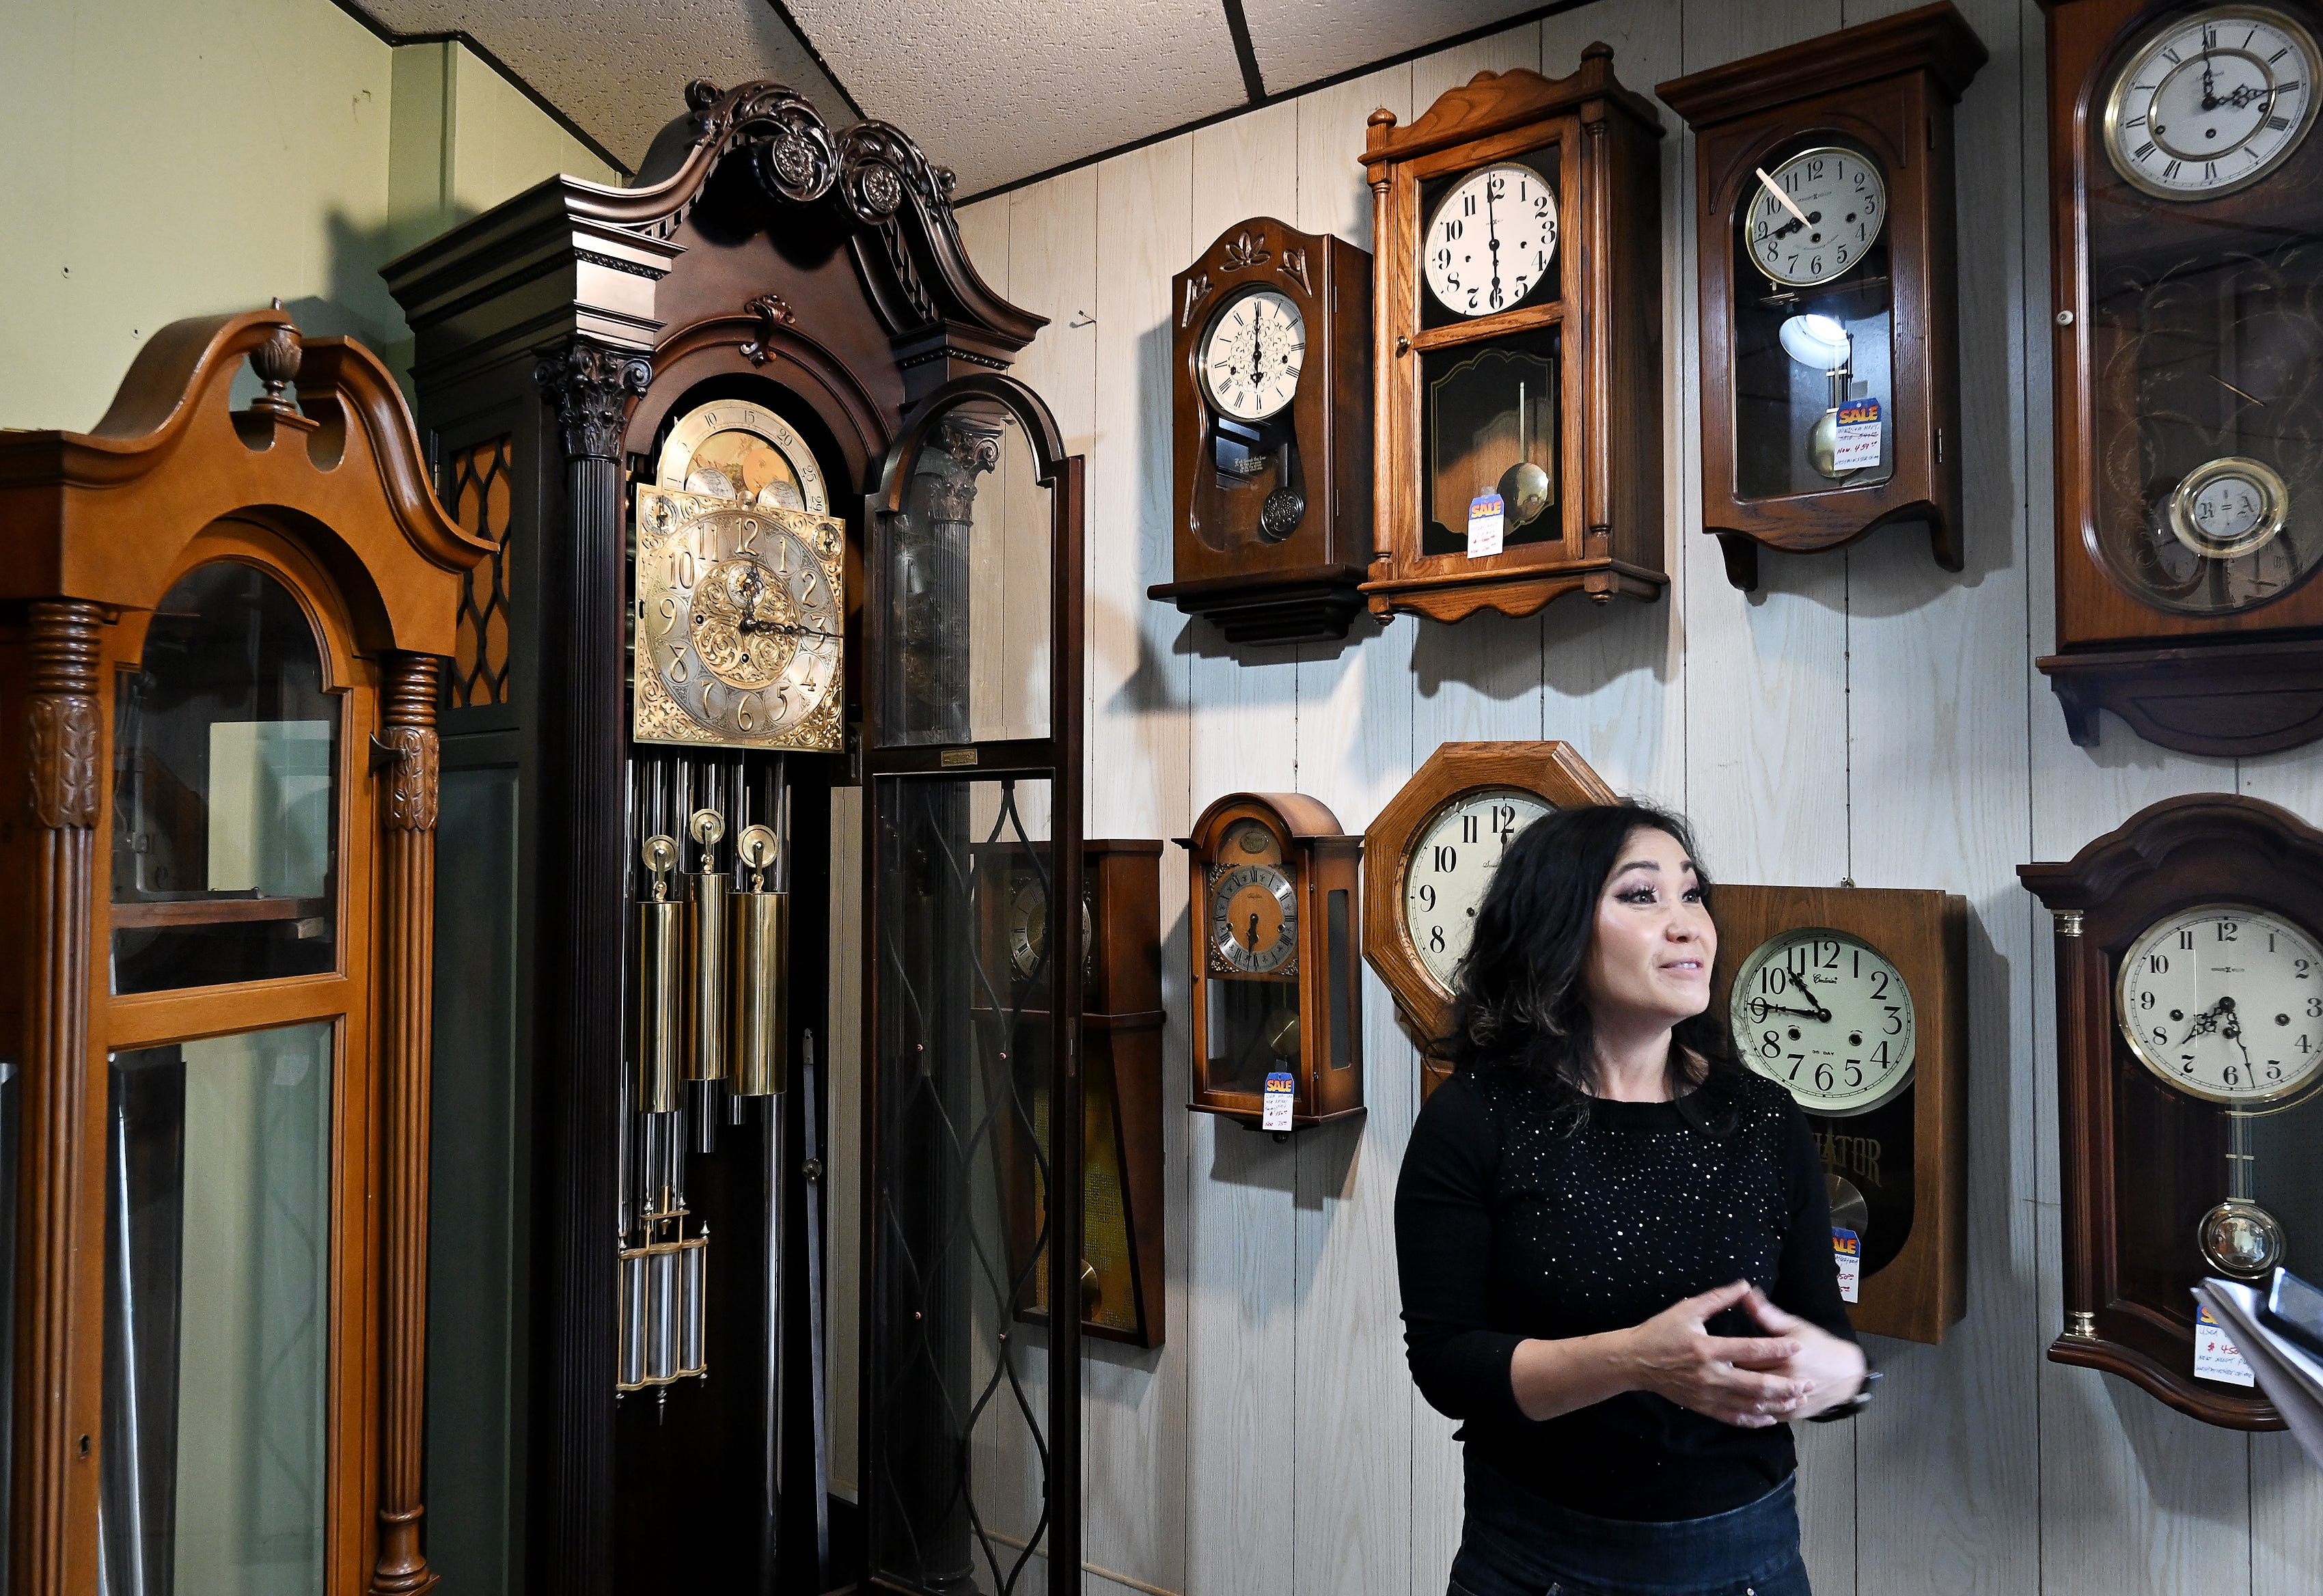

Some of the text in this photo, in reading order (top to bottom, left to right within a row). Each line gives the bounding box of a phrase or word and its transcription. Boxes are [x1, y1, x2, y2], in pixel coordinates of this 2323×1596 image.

[1807, 160, 1824, 182] 12
[1837, 161, 1843, 180] 1
[1487, 178, 1505, 203] 12
[1520, 181, 1526, 202] 1
[1785, 173, 1798, 193] 11
[1854, 172, 1865, 193] 2
[1465, 195, 1476, 217] 11
[1534, 197, 1548, 219] 2
[1766, 195, 1782, 215] 10
[1865, 194, 1875, 215] 3
[1446, 219, 1463, 242] 10
[1541, 221, 1556, 244] 3
[1758, 221, 1768, 238] 9
[1855, 223, 1866, 240] 4
[1438, 248, 1451, 270] 9
[1531, 251, 1547, 271] 4
[1767, 241, 1778, 262] 8
[1837, 244, 1847, 264] 5
[1788, 254, 1799, 274] 7
[1811, 255, 1822, 275] 6
[1447, 272, 1460, 293] 8
[1515, 275, 1528, 297] 5
[1468, 287, 1479, 308] 7
[1489, 288, 1503, 309] 6
[704, 412, 717, 427] 10
[745, 410, 755, 424] 15
[1839, 405, 1878, 424] SALE
[778, 428, 793, 446] 20
[803, 465, 816, 482] 25
[812, 497, 823, 512] 29
[1470, 499, 1502, 519] SALE
[698, 523, 719, 562] 11
[736, 517, 760, 556] 12
[780, 536, 788, 573] 1
[670, 551, 696, 590] 10
[803, 573, 819, 607] 2
[659, 598, 676, 635] 9
[811, 615, 827, 651] 3
[670, 645, 688, 683] 8
[800, 657, 816, 692] 4
[701, 681, 713, 719] 7
[773, 685, 789, 721] 5
[738, 695, 754, 732] 6
[1462, 815, 1477, 843] 11
[1492, 805, 1515, 834] 12
[1433, 845, 1457, 872] 10
[1419, 884, 1435, 912] 9
[1429, 925, 1445, 953] 8
[2180, 931, 2193, 950] 11
[2217, 922, 2238, 941] 12
[2268, 933, 2275, 952] 1
[1788, 947, 1805, 976] 11
[1813, 940, 1841, 968] 12
[1854, 950, 1858, 978] 1
[2150, 954, 2169, 974] 10
[2295, 959, 2309, 978] 2
[1761, 967, 1786, 995] 10
[1870, 971, 1888, 1000] 2
[1750, 997, 1768, 1023] 9
[2141, 991, 2155, 1010] 9
[2307, 998, 2322, 1017] 3
[1882, 1006, 1902, 1035] 3
[1761, 1030, 1781, 1058] 8
[2153, 1026, 2167, 1045] 8
[2294, 1034, 2311, 1053] 4
[1869, 1041, 1891, 1069] 4
[2182, 1055, 2195, 1073] 7
[1787, 1054, 1805, 1080] 7
[1815, 1062, 1833, 1091] 6
[1844, 1059, 1862, 1087] 5
[2223, 1066, 2238, 1085] 6
[2266, 1060, 2281, 1079] 5
[1266, 1079, 1292, 1092] SALE
[1833, 1237, 1856, 1254] ALE
